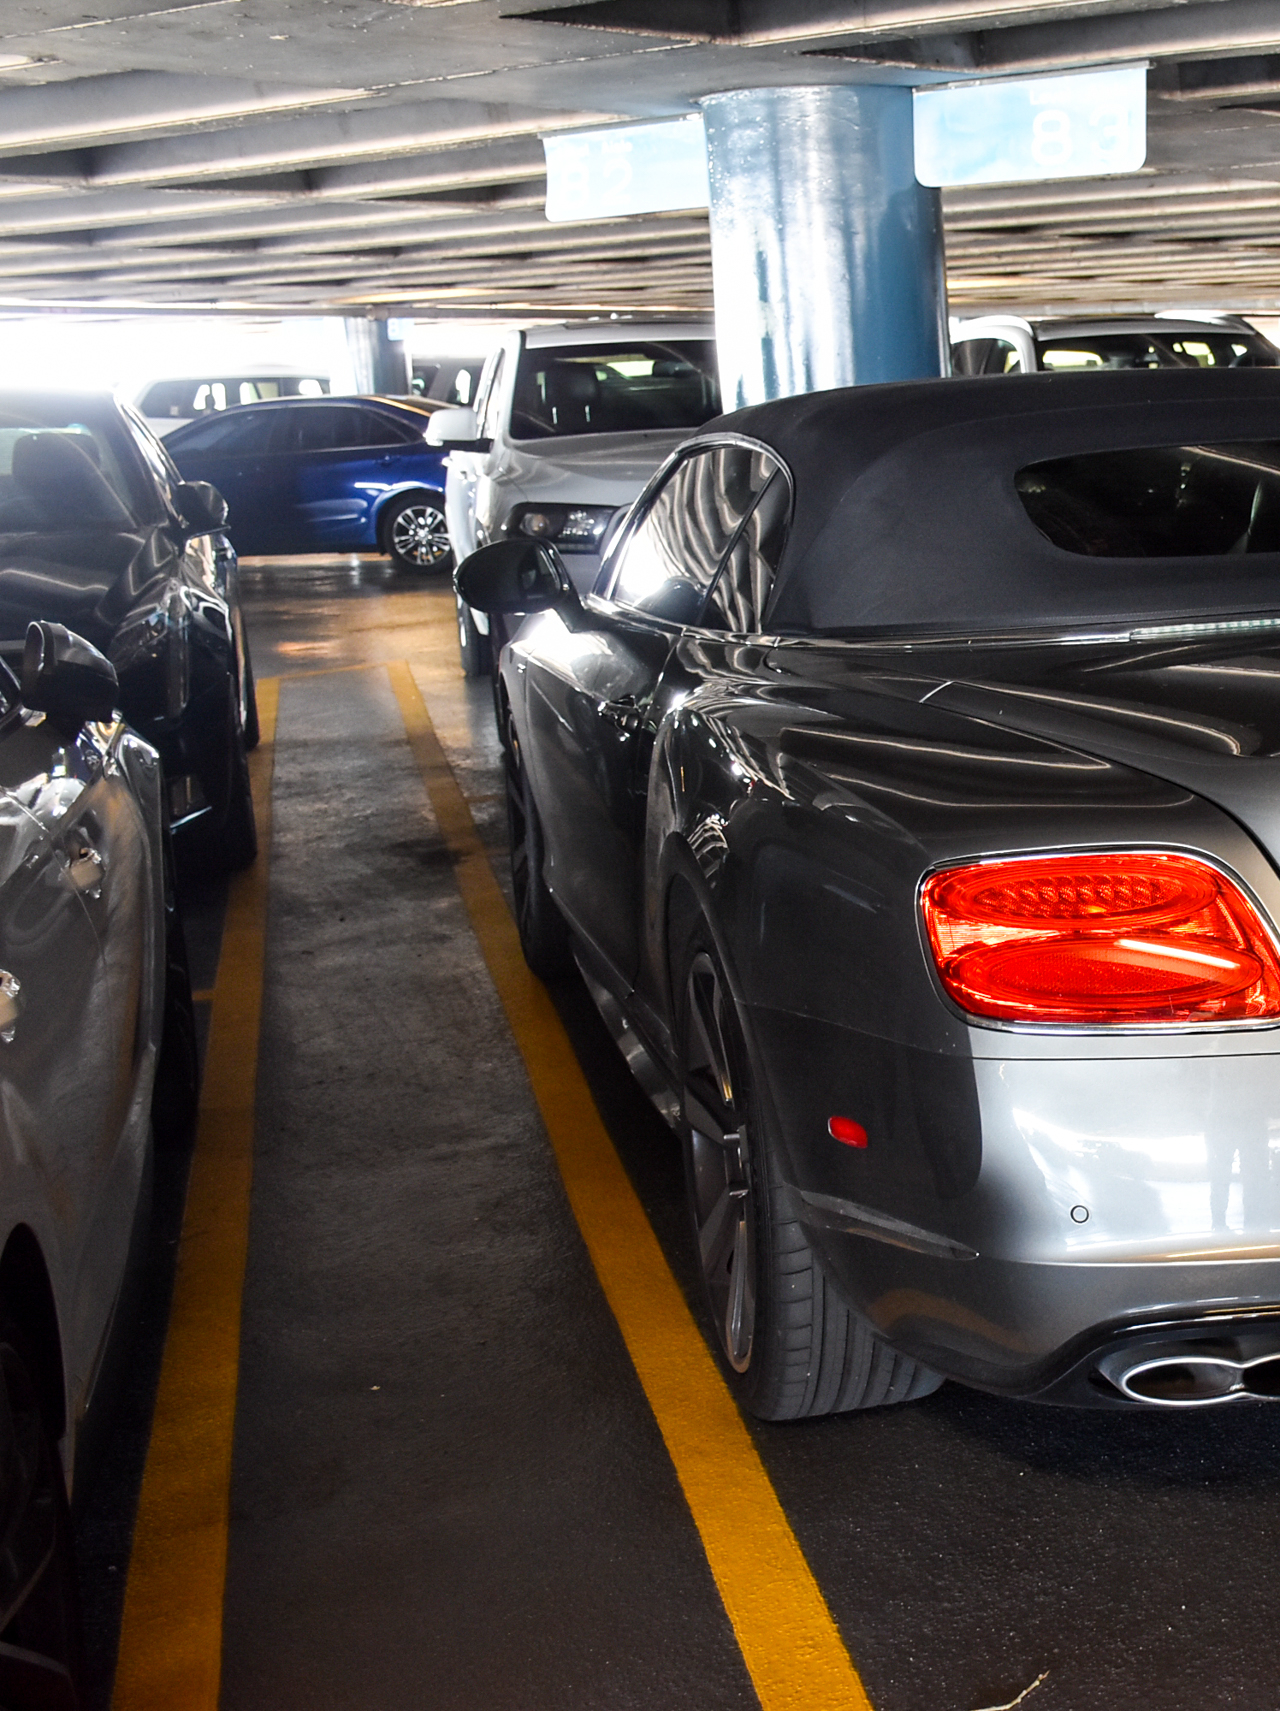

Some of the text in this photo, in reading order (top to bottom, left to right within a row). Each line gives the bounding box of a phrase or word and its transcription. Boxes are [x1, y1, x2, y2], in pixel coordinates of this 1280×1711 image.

[1031, 104, 1128, 166] 8 3
[560, 158, 634, 209] 8 2
